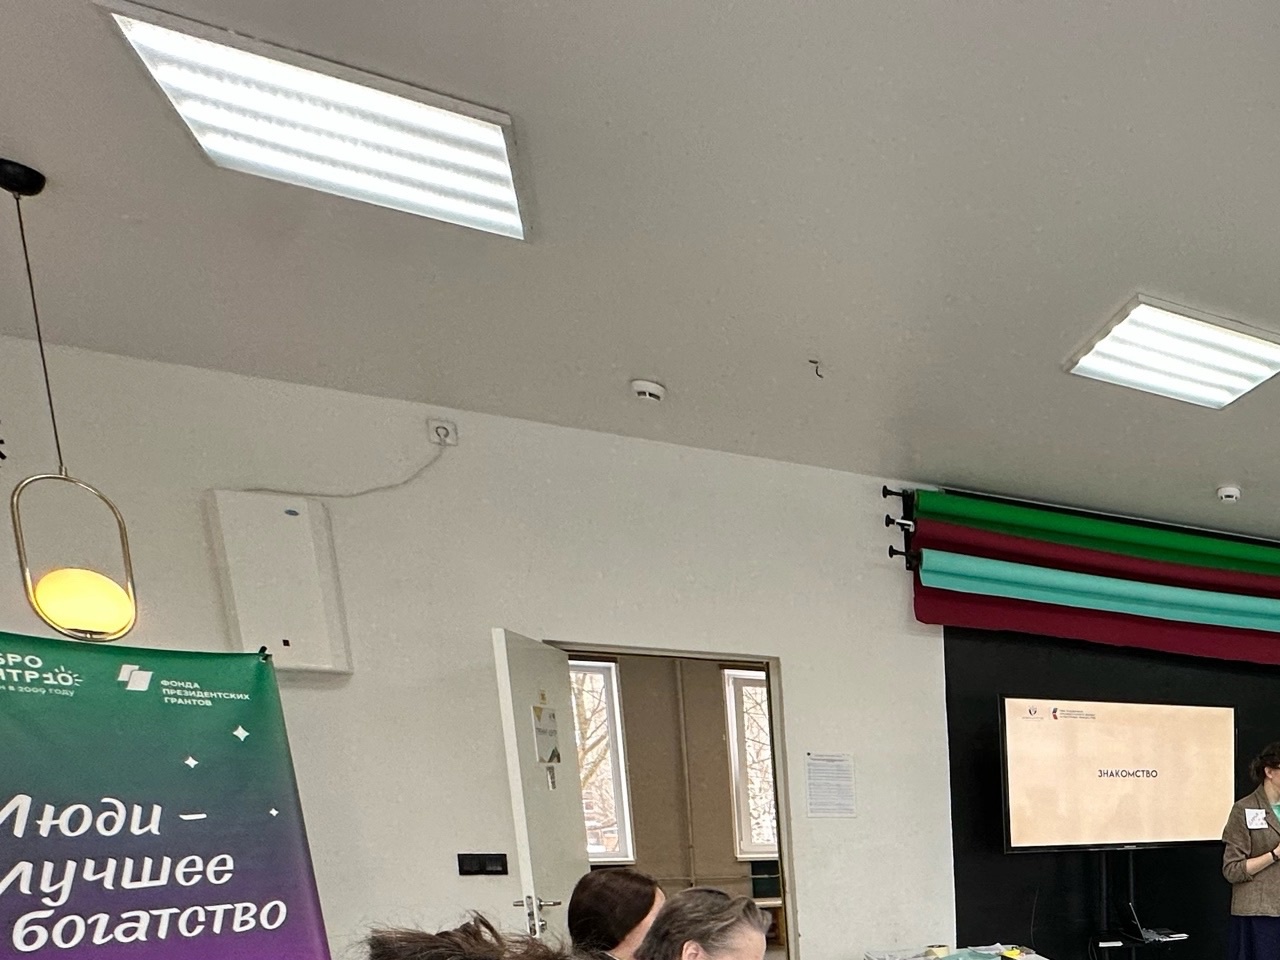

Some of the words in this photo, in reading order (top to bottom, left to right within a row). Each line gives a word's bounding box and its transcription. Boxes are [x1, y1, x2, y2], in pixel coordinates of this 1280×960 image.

[160, 679, 200, 689] ФОНДА
[162, 688, 250, 700] ПРЕЗИДЕНТСКИХ
[164, 696, 213, 706] ГРАНТОВ
[1097, 769, 1158, 778] ЗНАКОМСТВО
[0, 794, 163, 838] Люди
[0, 853, 235, 907] лучшее
[12, 900, 287, 952] богатство
